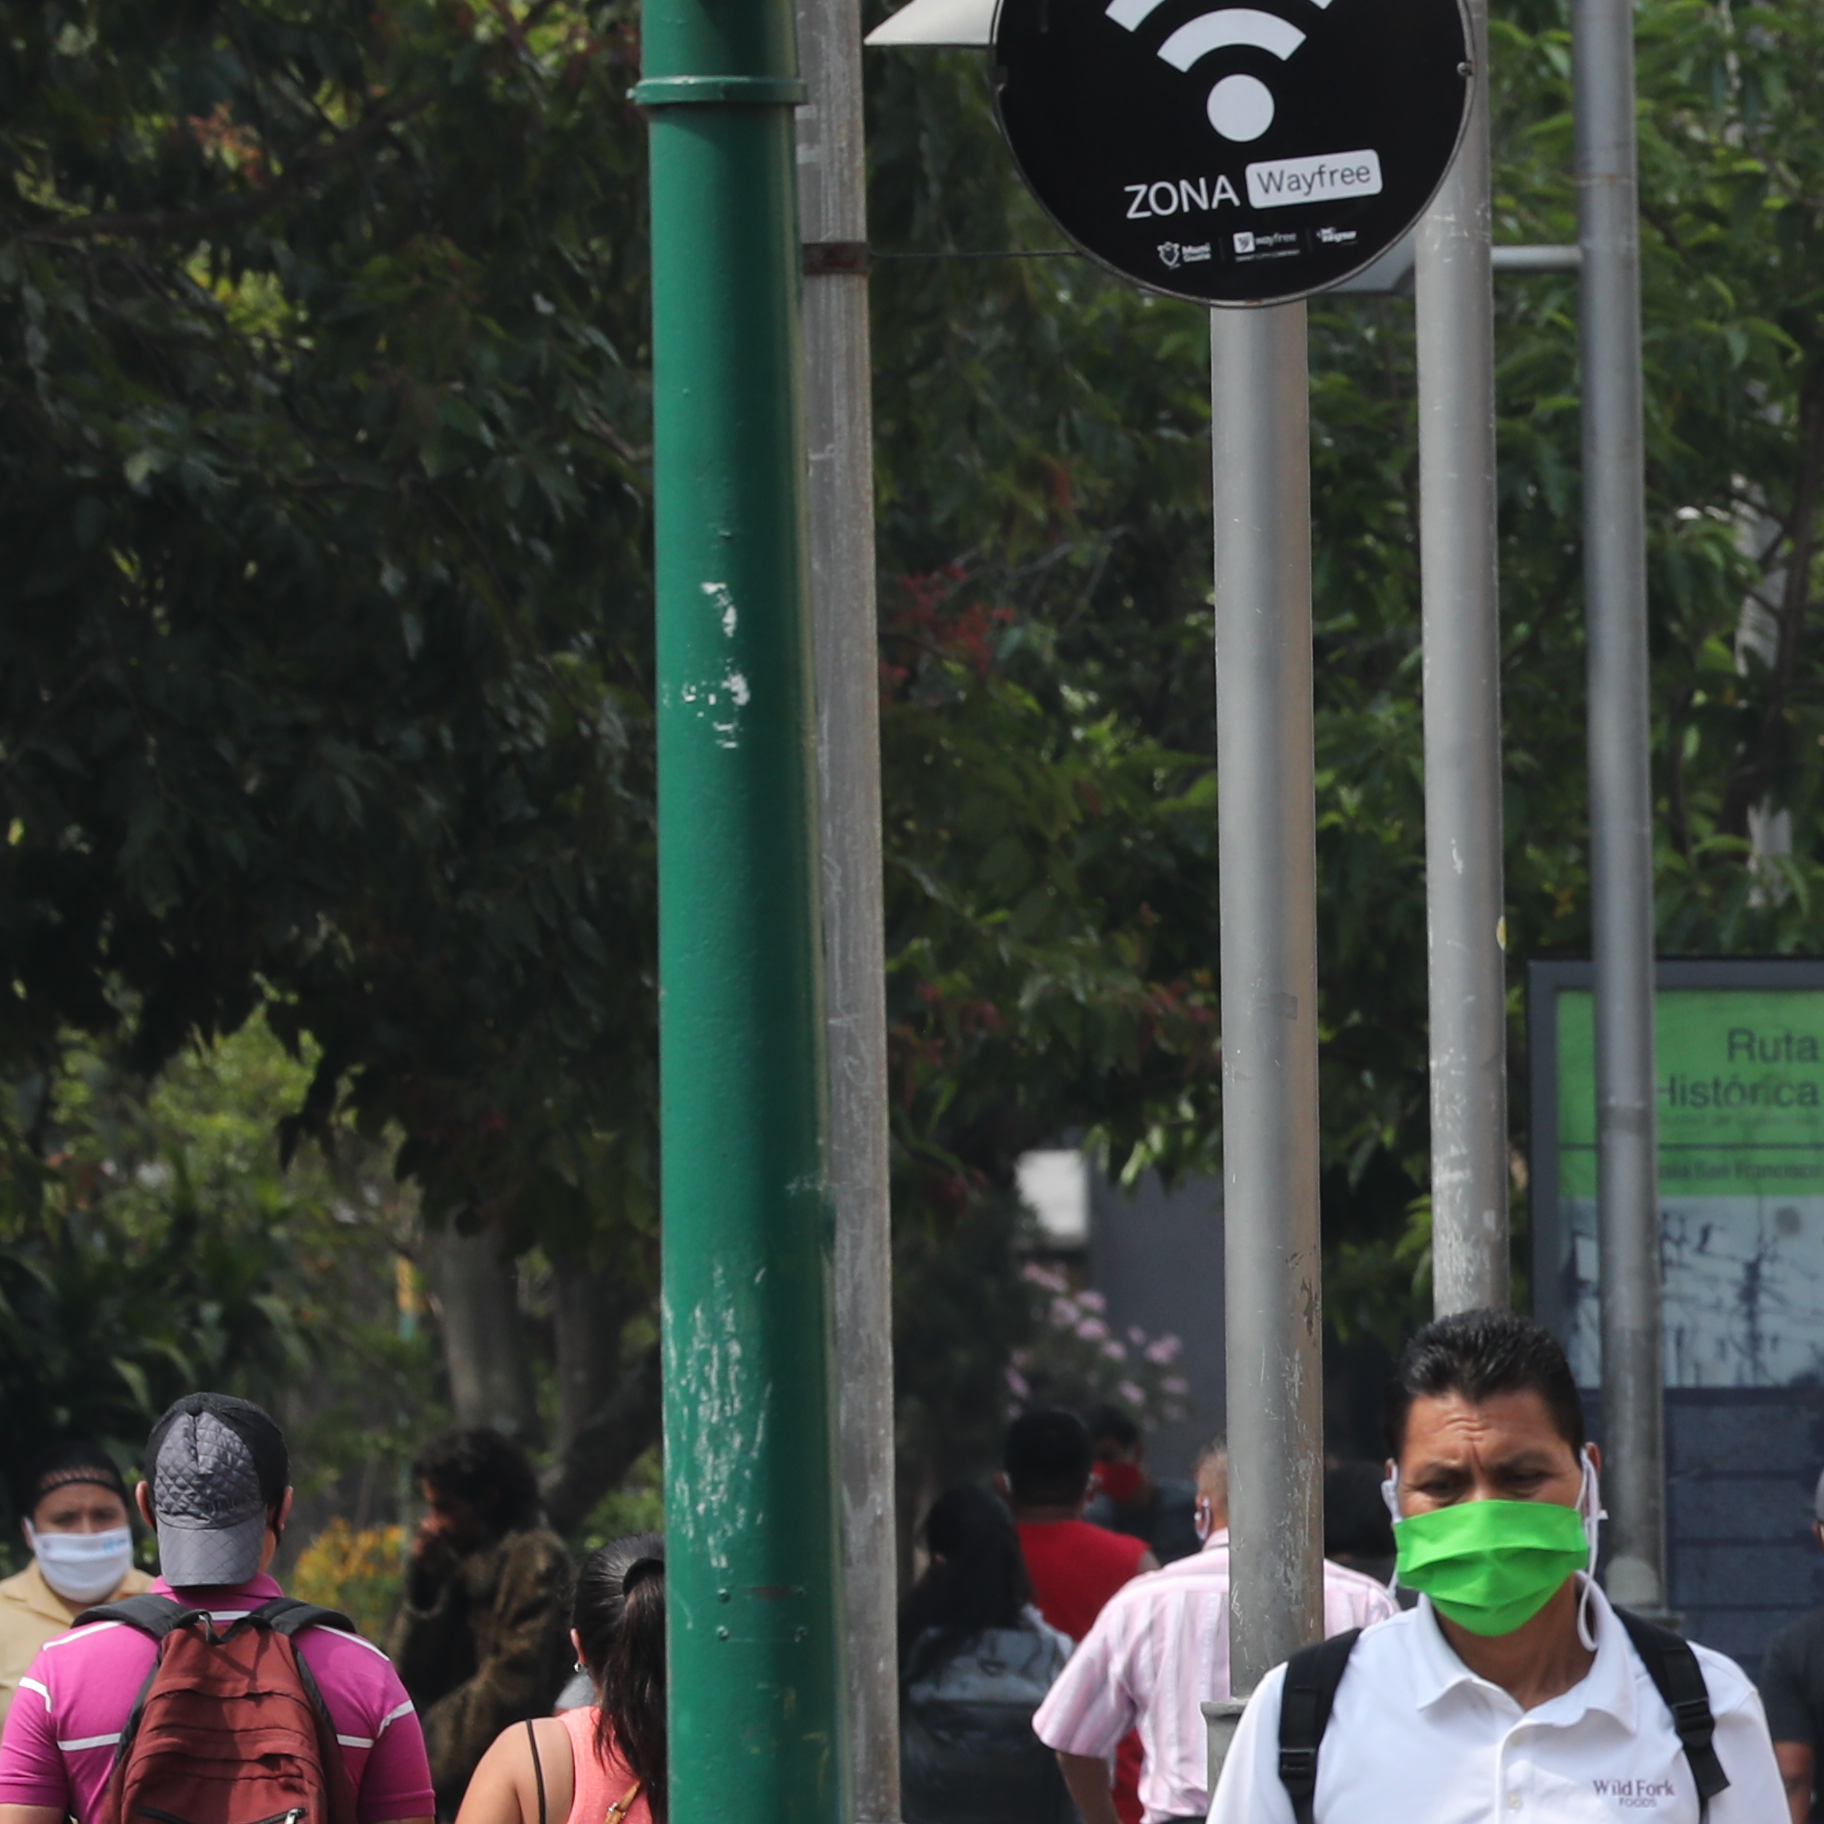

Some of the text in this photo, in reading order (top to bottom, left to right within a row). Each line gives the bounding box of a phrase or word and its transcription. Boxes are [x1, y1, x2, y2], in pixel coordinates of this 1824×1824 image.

[1124, 163, 1372, 219] ZONA Wayfree
[1727, 1026, 1820, 1064] Ruta
[1592, 1779, 1675, 1796] Wild Fork
